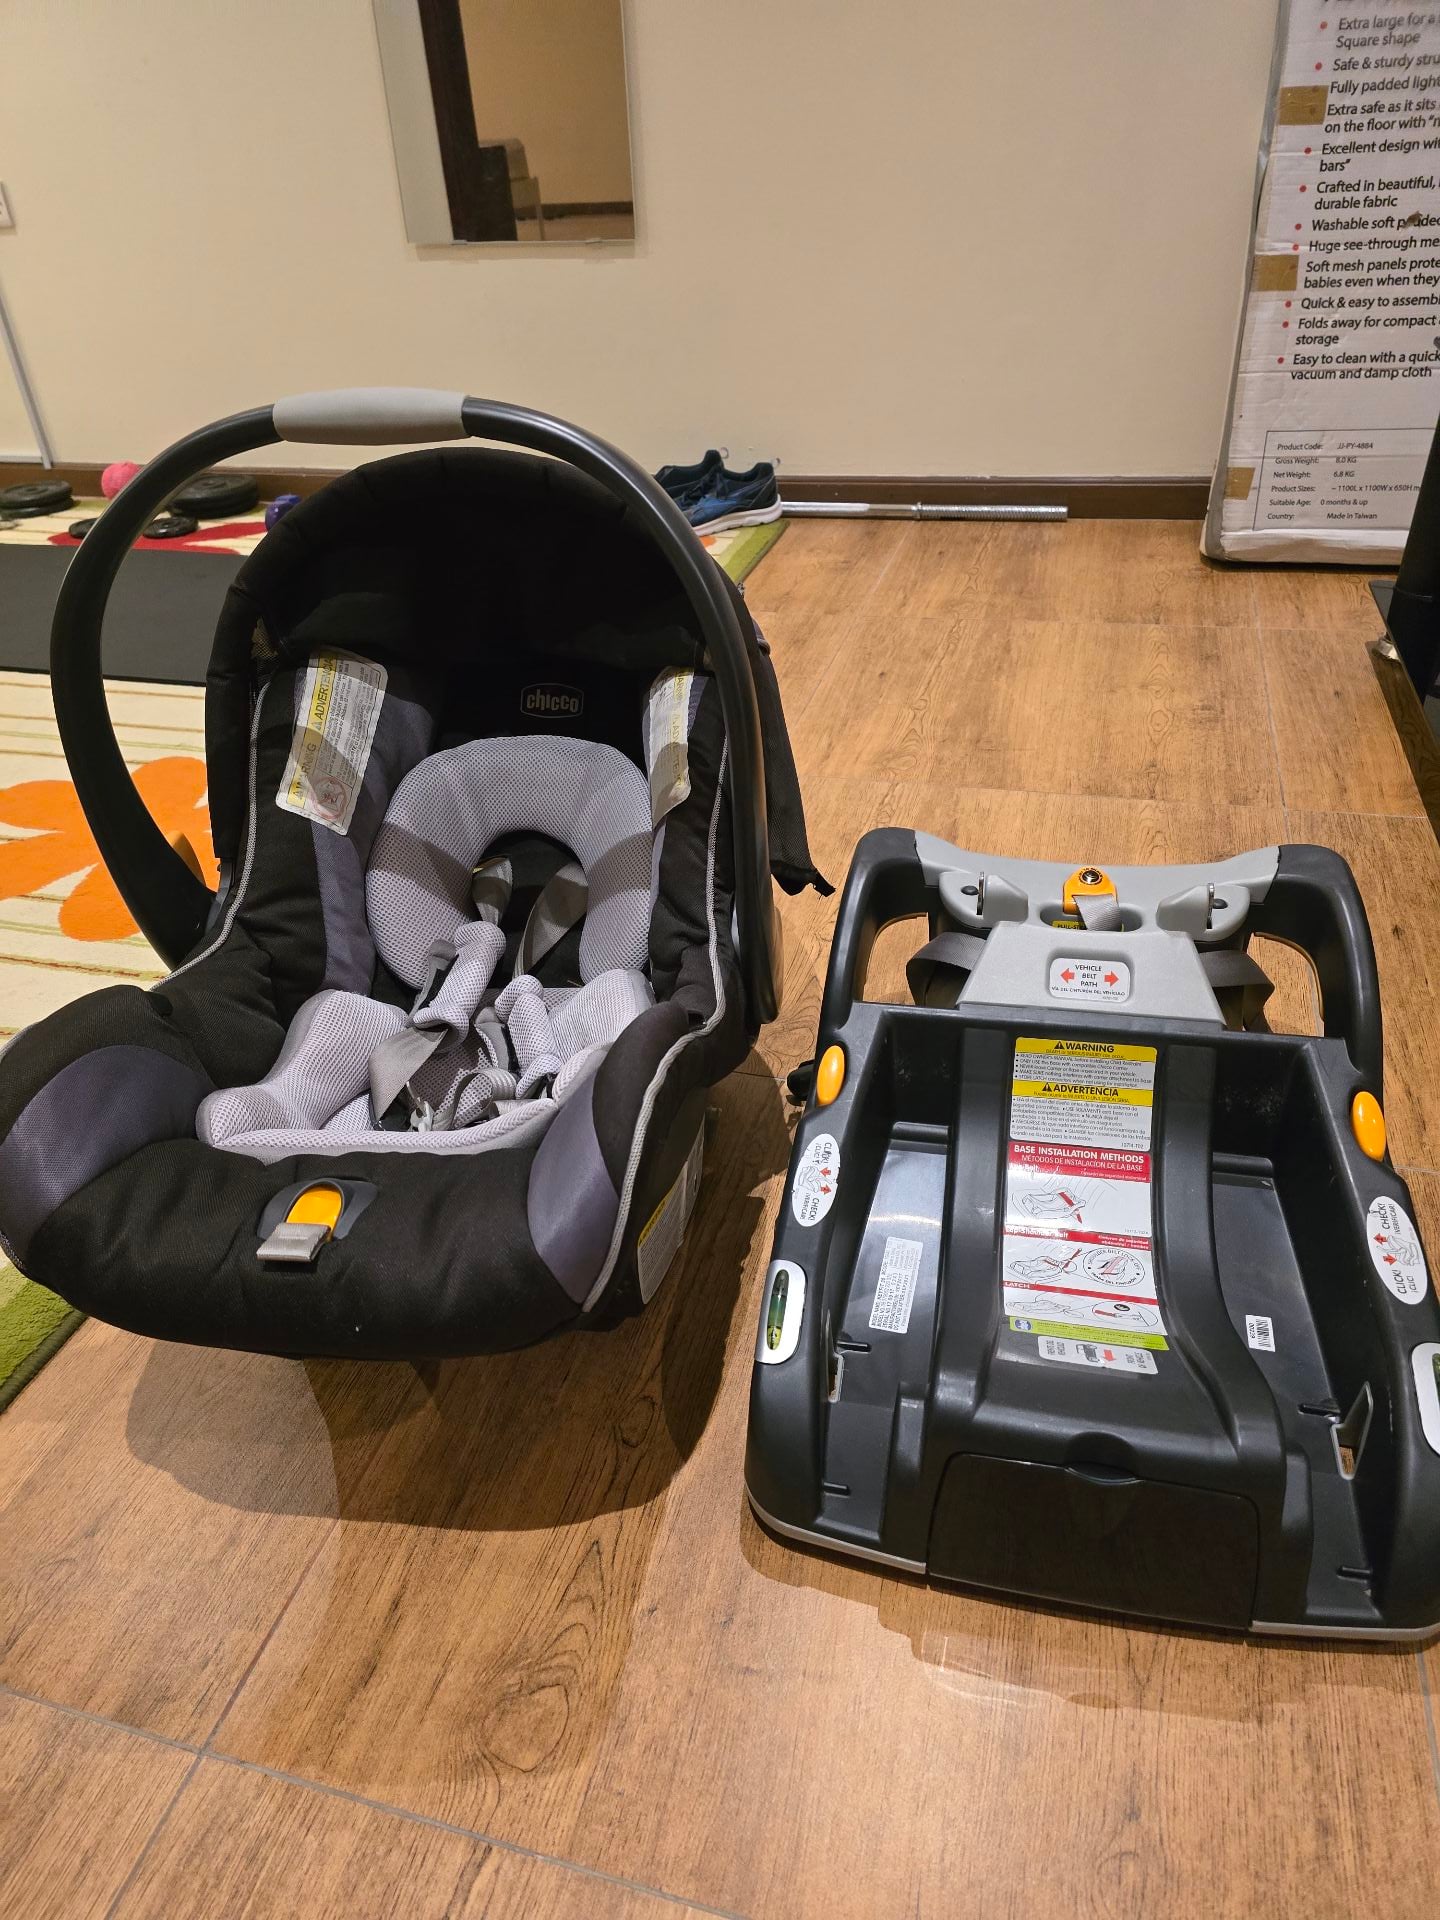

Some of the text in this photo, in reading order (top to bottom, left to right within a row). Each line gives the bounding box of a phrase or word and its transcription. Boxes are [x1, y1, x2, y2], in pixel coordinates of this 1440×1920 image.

[1338, 12, 1436, 31] Extra large for a
[1335, 31, 1422, 50] Square shape
[1333, 57, 1360, 71] Safe
[1361, 56, 1372, 70] &
[1374, 53, 1415, 71] sturdy
[1330, 80, 1360, 96] Fully
[1361, 76, 1411, 96] padded
[1327, 98, 1437, 117] Extra safe as it sits
[1324, 122, 1341, 134] on
[1344, 118, 1364, 132] the
[1366, 116, 1397, 131] floor
[1399, 115, 1426, 130] with
[1321, 141, 1377, 156] Excellent
[1380, 138, 1420, 154] design
[1316, 175, 1436, 194] Crafted in beautiful,
[1314, 195, 1398, 210] durable fabric
[1311, 215, 1370, 231] Washable
[1371, 215, 1395, 229] soft
[1308, 241, 1341, 254] Huge
[1343, 236, 1417, 251] see-through
[1306, 259, 1330, 273] Soft
[1332, 259, 1364, 272] mesh
[1367, 257, 1407, 273] panels
[1304, 272, 1440, 289] babies even when they
[1301, 297, 1334, 310] Quick
[1336, 296, 1346, 309] &
[1348, 298, 1375, 311] easy
[1377, 296, 1390, 307] to
[1298, 315, 1436, 331] Folds away for compact
[1295, 333, 1339, 347] storage
[1292, 350, 1440, 367] Easy to clean with a quick
[1290, 366, 1432, 381] vacuum and damp cloth
[1276, 443, 1303, 451] Product
[1274, 457, 1293, 465] Gross
[1346, 456, 1357, 464] KG
[1273, 471, 1286, 479] Net
[1344, 470, 1355, 478] KG
[1271, 484, 1296, 492] Product
[1269, 498, 1295, 506] Suitable
[1325, 498, 1351, 506] months
[1326, 512, 1346, 520] Made
[1354, 512, 1378, 520] Taiwan
[526, 688, 580, 713] chicco
[1075, 964, 1102, 972] VEHICLE
[1066, 1041, 1115, 1053] WARNING
[1053, 1083, 1119, 1096] ADVERTENCIA
[1014, 1144, 1144, 1164] BASE INSTALLATION METHODS
[1126, 1164, 1143, 1172] BASE
[807, 1197, 820, 1221] CHECK!
[1377, 1202, 1391, 1230] CHECK!
[1004, 1281, 1031, 1289] LATCH
[1391, 1269, 1407, 1295] CLICK!
